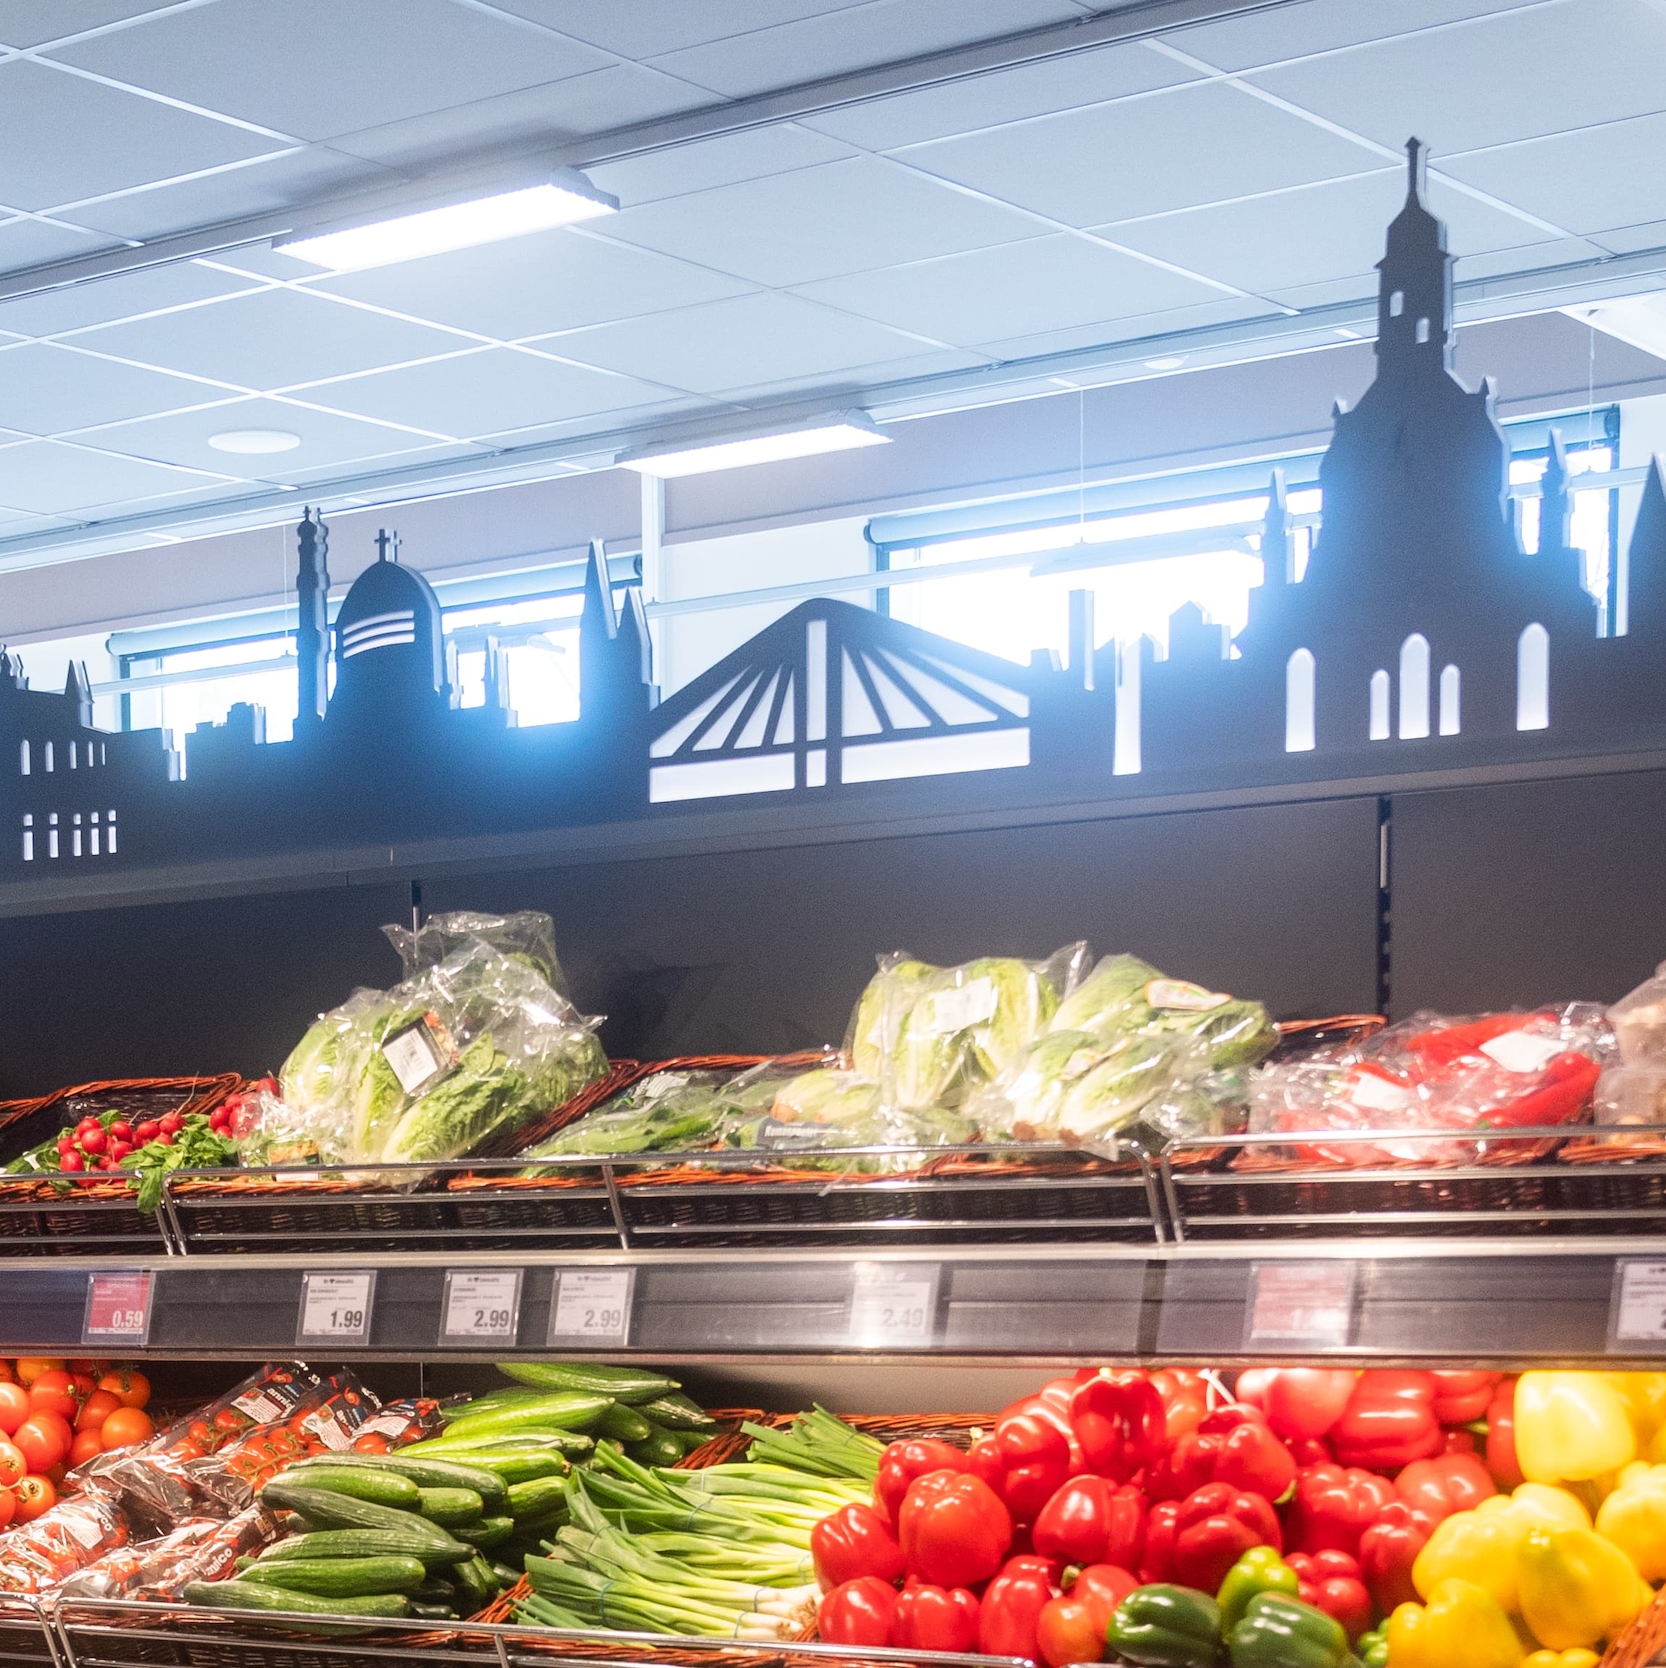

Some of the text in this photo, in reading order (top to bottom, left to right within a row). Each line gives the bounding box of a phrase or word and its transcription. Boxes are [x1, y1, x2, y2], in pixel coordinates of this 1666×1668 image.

[112, 1311, 143, 1328] 0.59
[330, 1311, 362, 1327] 1.99
[474, 1310, 509, 1328] 2.99
[585, 1310, 621, 1328] 2.99
[882, 1308, 923, 1328] 2.49
